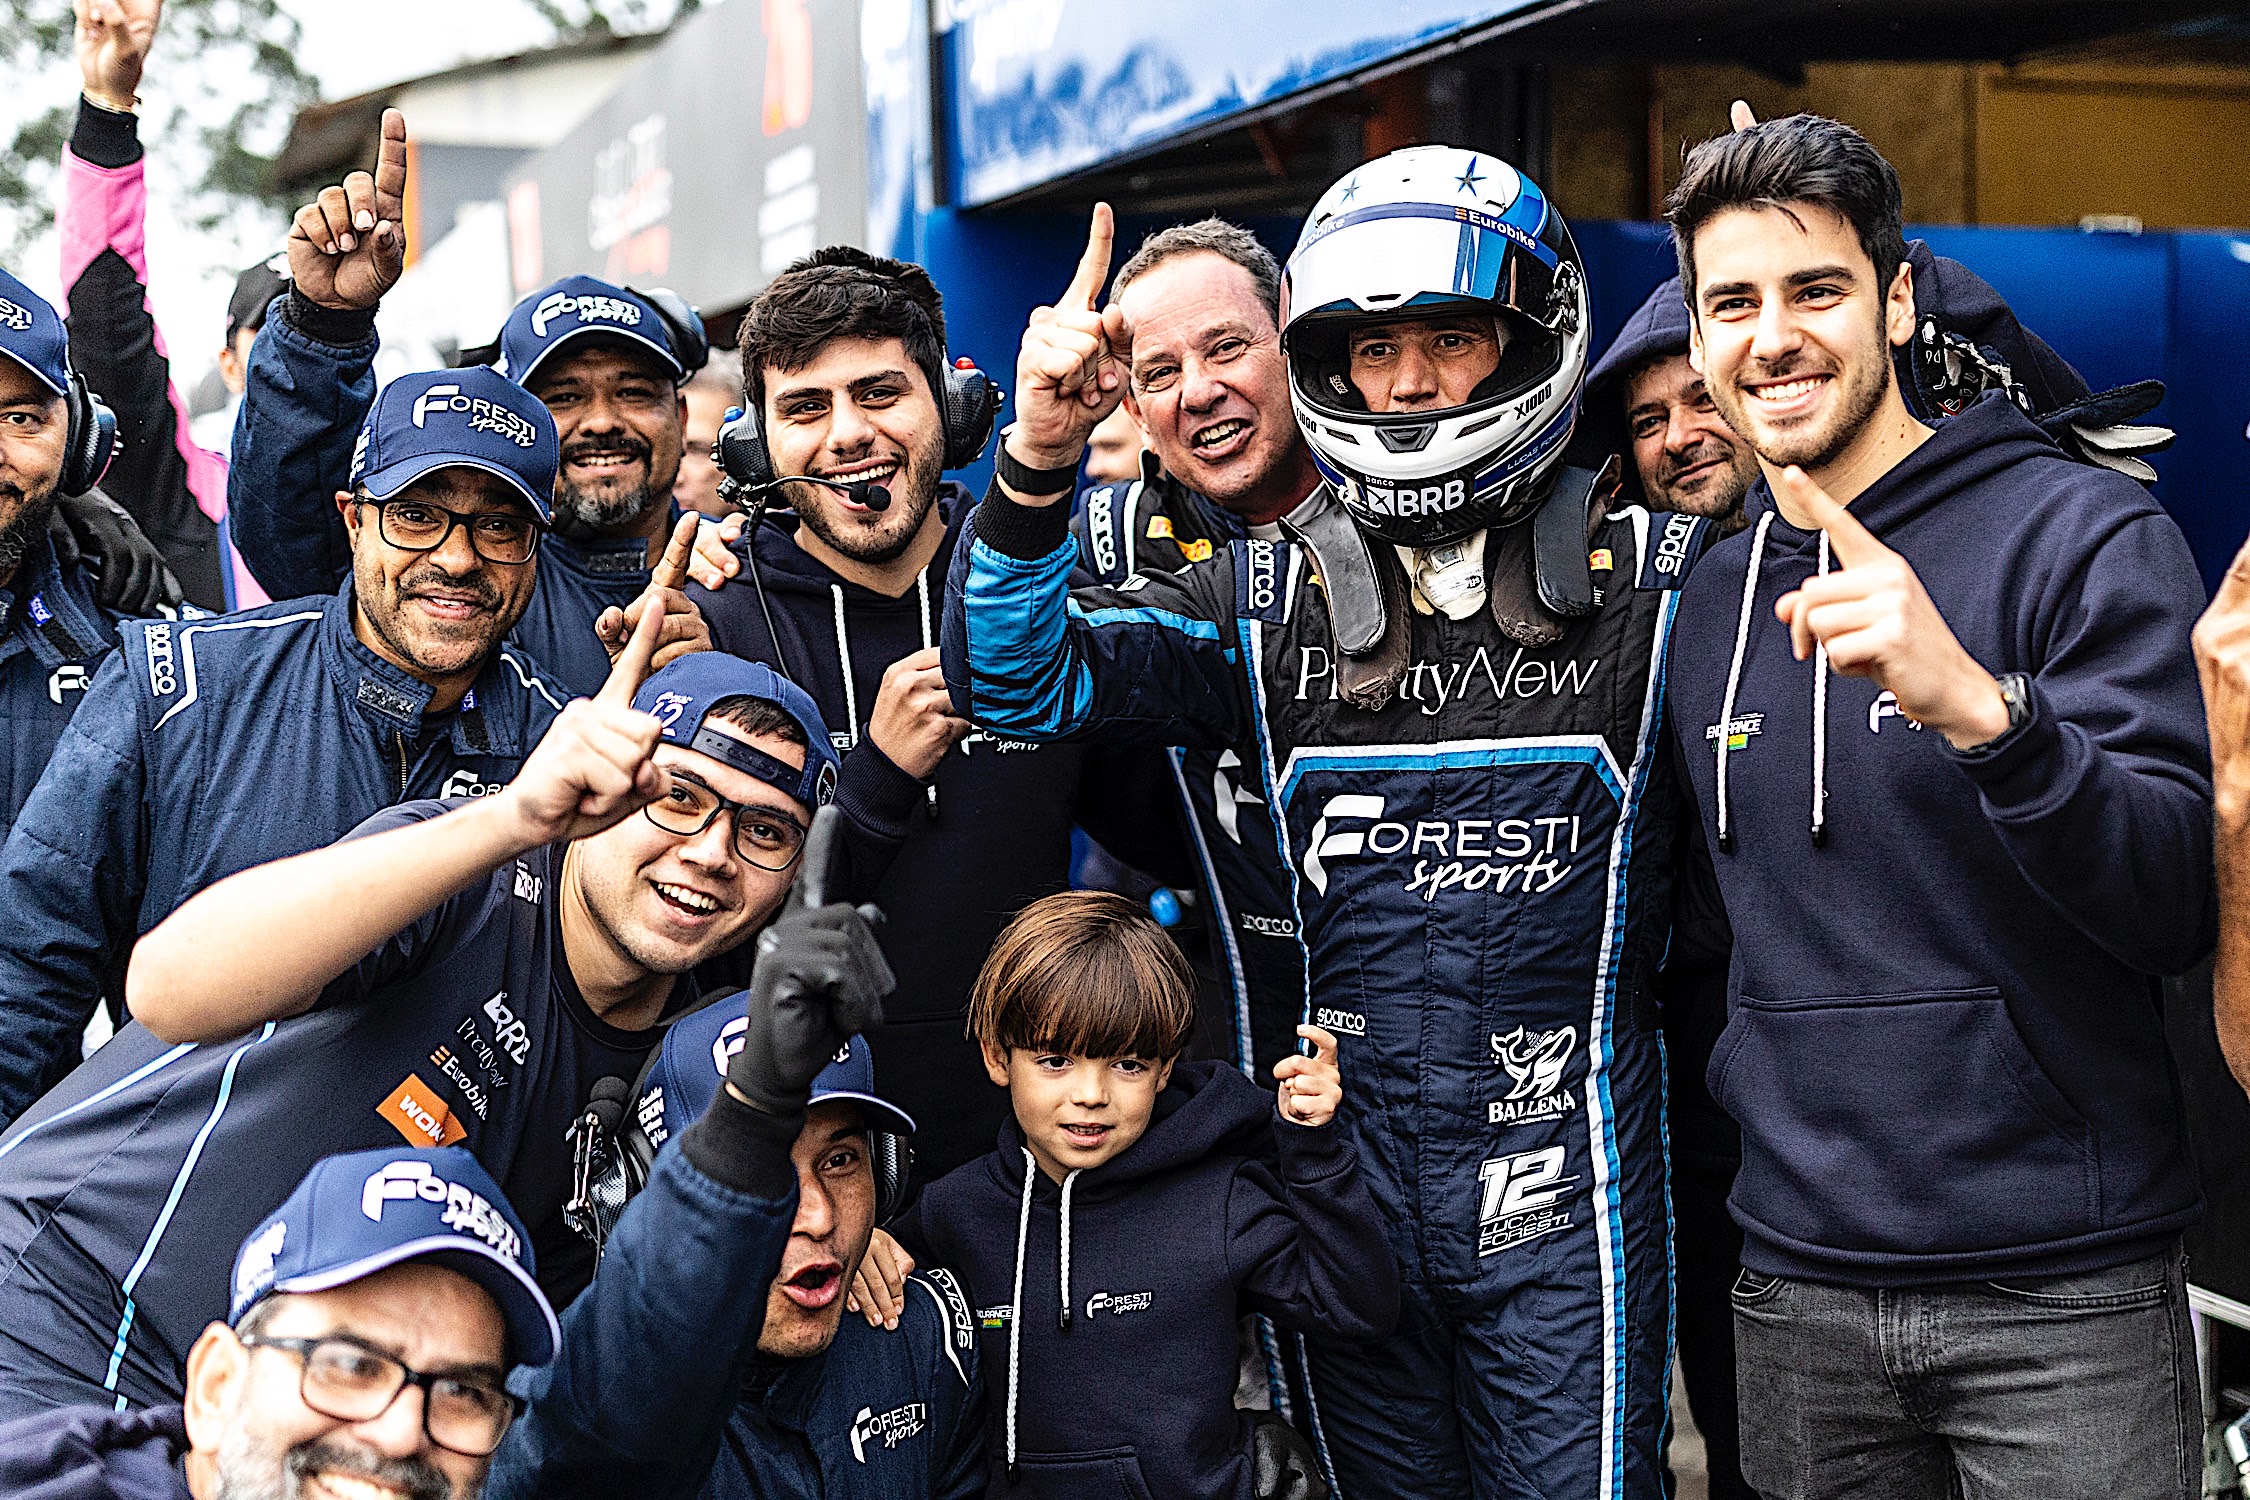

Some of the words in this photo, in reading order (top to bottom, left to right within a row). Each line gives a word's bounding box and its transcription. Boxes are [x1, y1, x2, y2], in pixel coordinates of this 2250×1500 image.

[1468, 210, 1536, 250] Eurobike
[531, 292, 641, 337] FORESTI
[412, 384, 536, 441] FORESTI
[1513, 382, 1552, 421] X1000
[467, 414, 535, 447] sports
[1365, 475, 1395, 487] banco
[1397, 479, 1466, 517] BRB
[145, 623, 177, 696] sparco
[1303, 794, 1581, 897] FORESTI
[1404, 848, 1571, 901] sports
[1316, 1007, 1366, 1036] sparco
[441, 1055, 488, 1121] Eurobik
[1488, 1089, 1576, 1124] BALLENA
[1477, 1145, 1568, 1223] 12
[361, 1160, 521, 1258] FORESTI
[1480, 1208, 1554, 1238] LUCAS
[1478, 1212, 1571, 1251] FORESTI
[927, 1267, 973, 1350] sparco
[1086, 1291, 1152, 1319] FORESTI
[1113, 1299, 1151, 1315] sports
[850, 1402, 926, 1464] FORESTI
